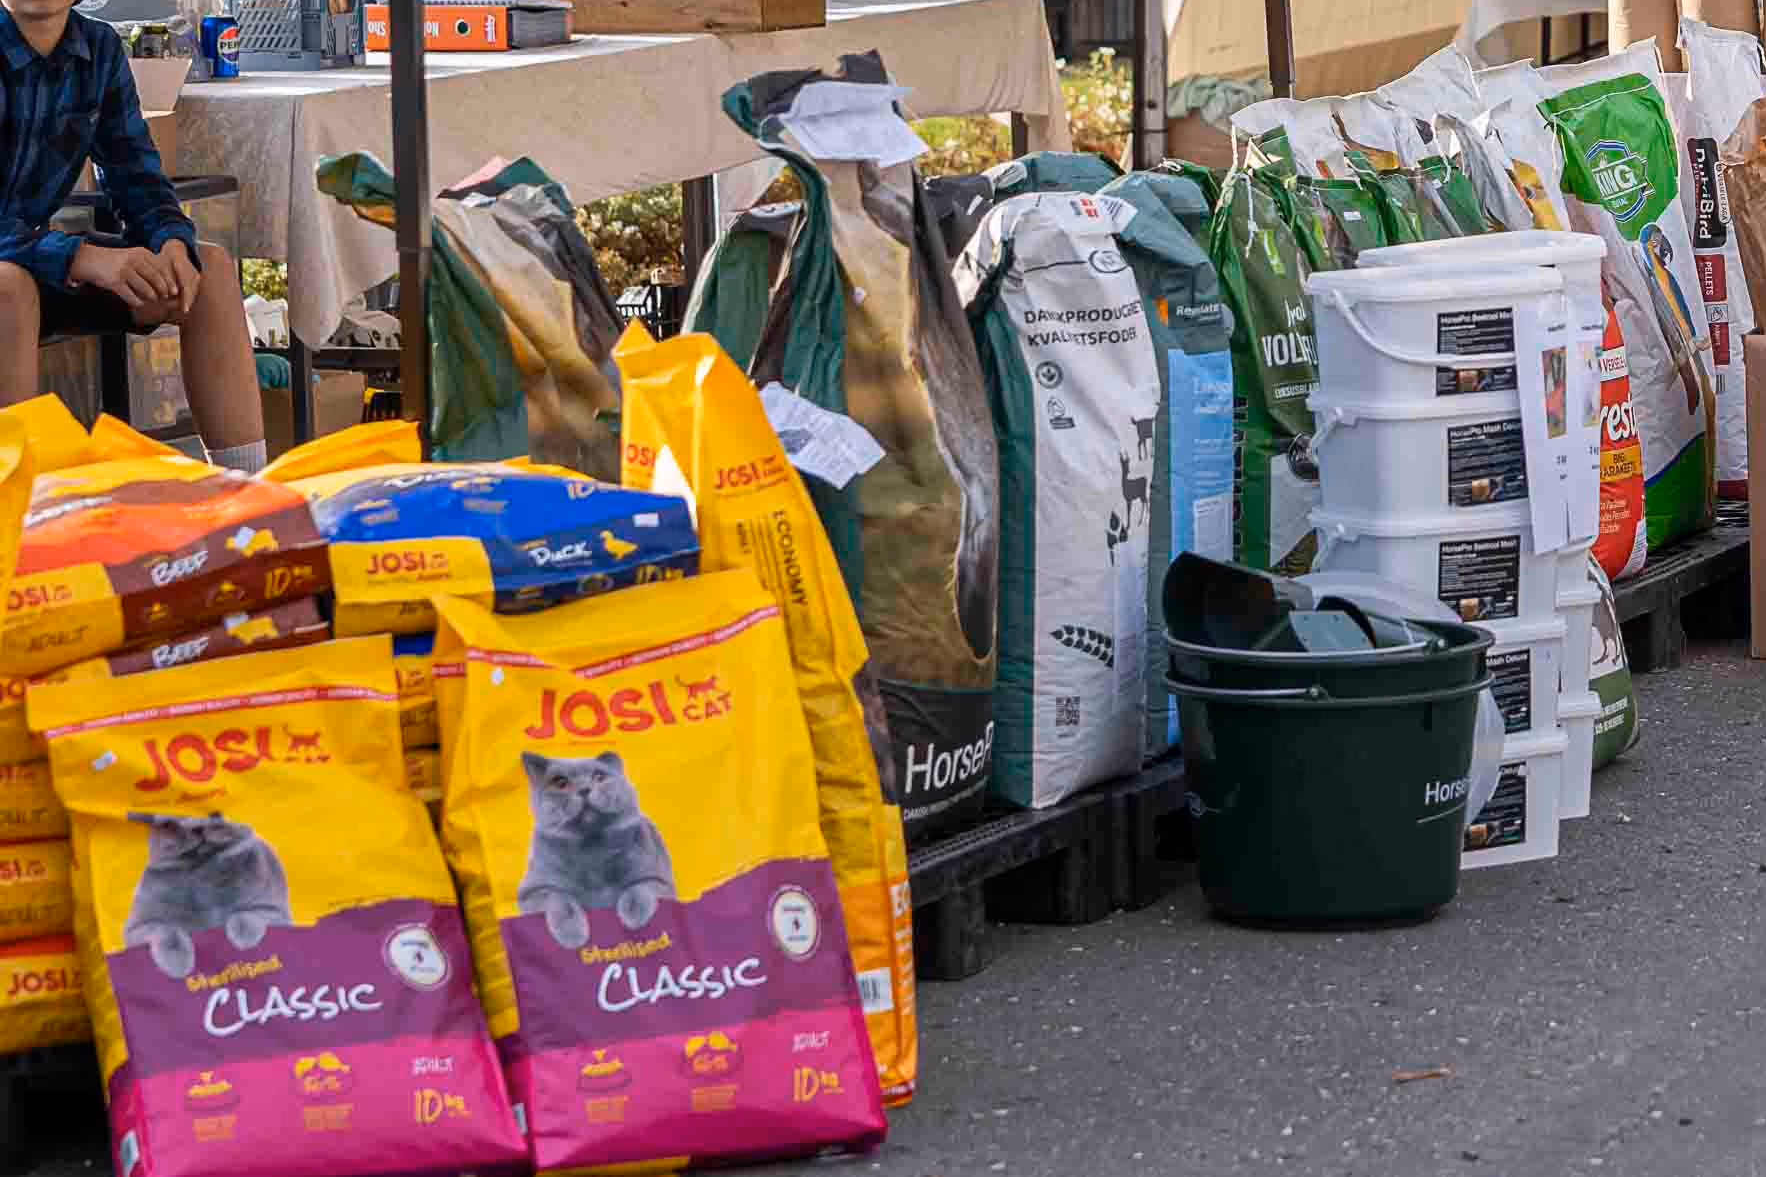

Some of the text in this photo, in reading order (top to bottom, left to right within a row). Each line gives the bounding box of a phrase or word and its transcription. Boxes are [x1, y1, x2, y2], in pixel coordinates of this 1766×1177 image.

[1703, 260, 1714, 296] PELLETS
[364, 550, 425, 575] JOSI
[523, 680, 733, 740] JOSI CAT
[133, 726, 272, 793] JOSI
[203, 983, 383, 1037] CLASSIC
[597, 958, 768, 1012] CLASSIC
